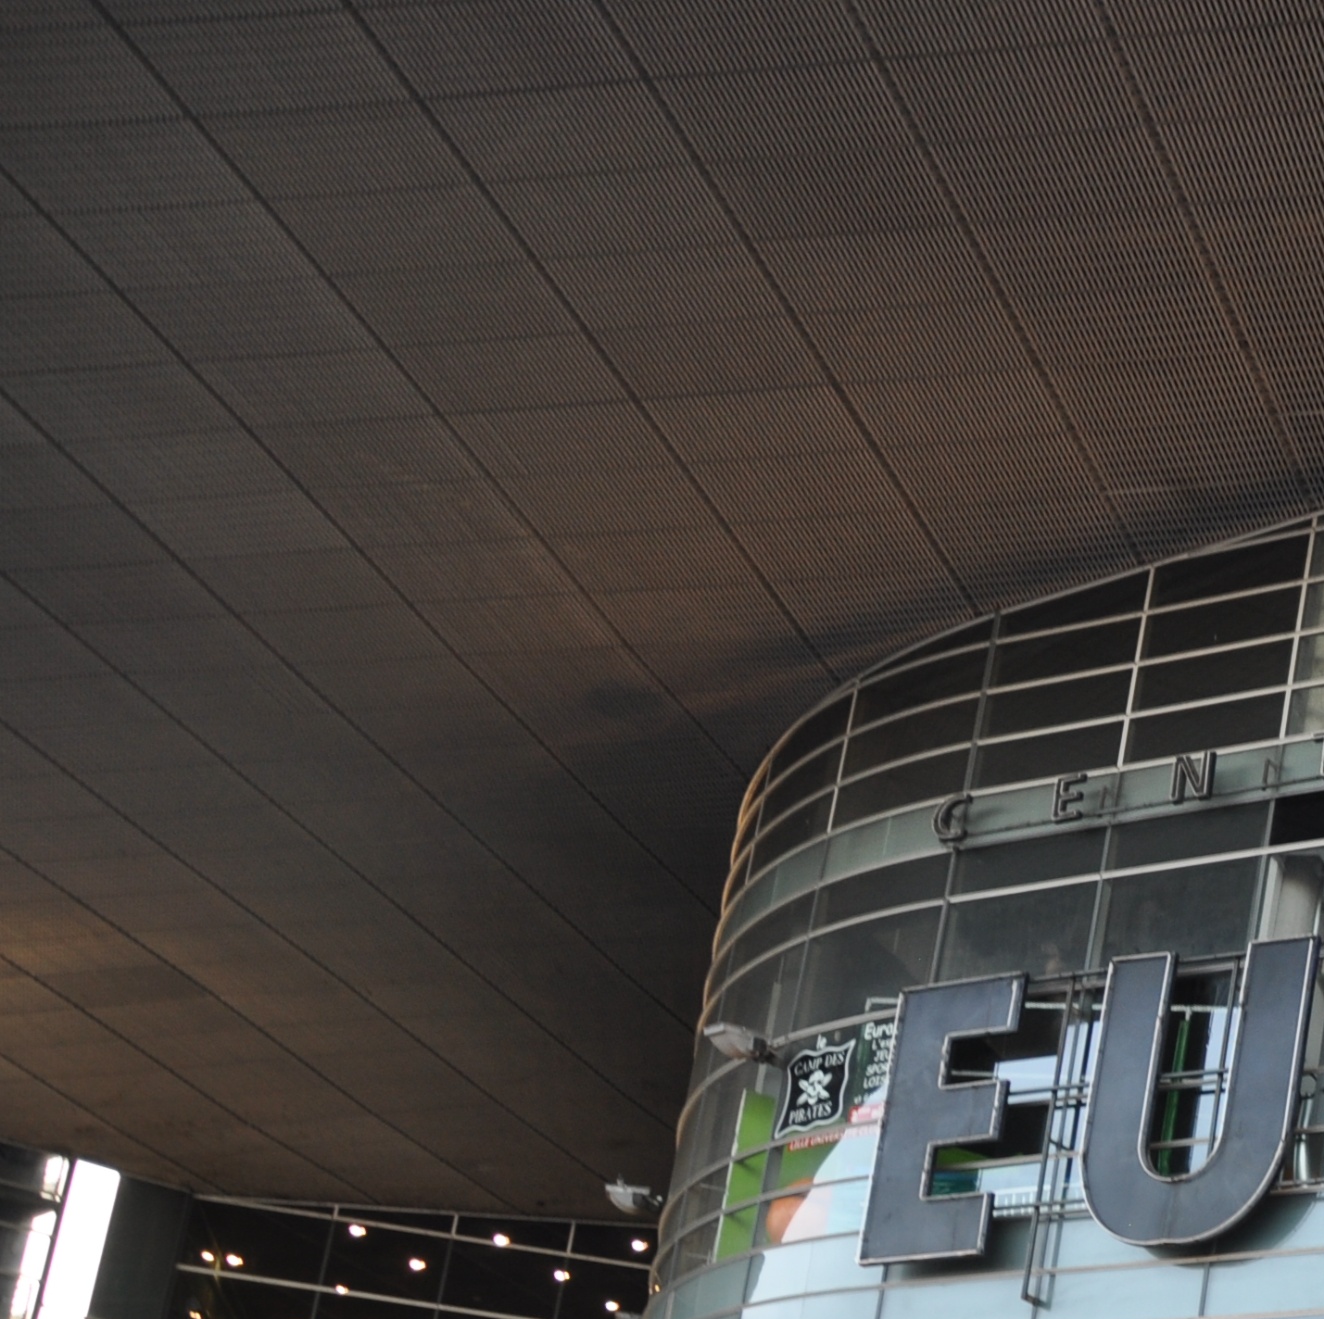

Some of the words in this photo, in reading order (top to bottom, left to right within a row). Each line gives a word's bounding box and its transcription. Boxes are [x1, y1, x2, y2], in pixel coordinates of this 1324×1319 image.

[793, 1057, 824, 1077] CAMP
[824, 1050, 845, 1068] DES
[788, 1101, 833, 1125] PIRATES
